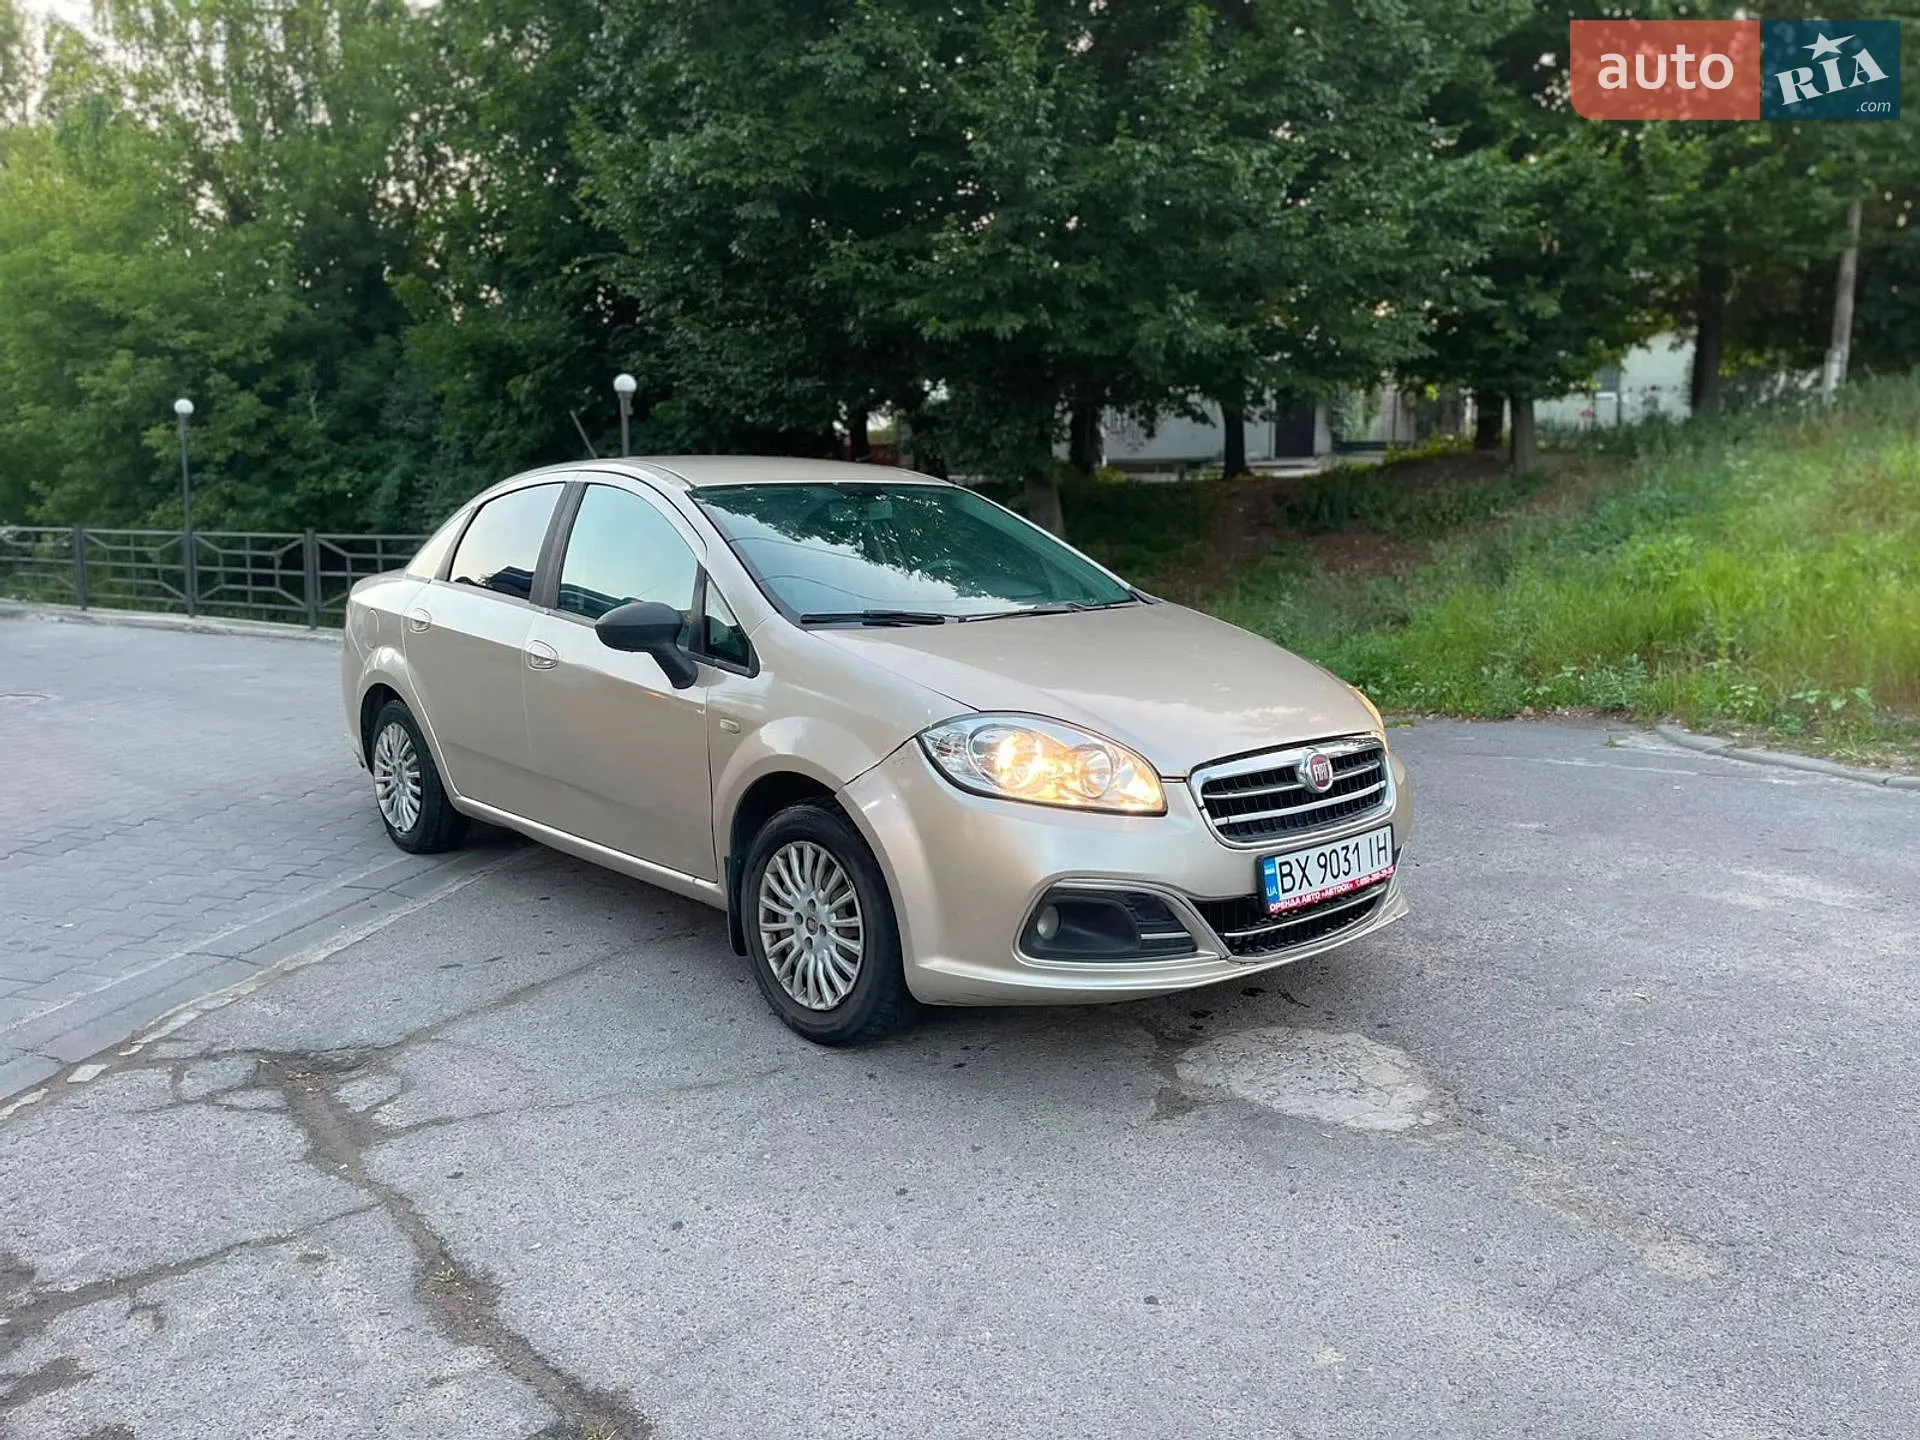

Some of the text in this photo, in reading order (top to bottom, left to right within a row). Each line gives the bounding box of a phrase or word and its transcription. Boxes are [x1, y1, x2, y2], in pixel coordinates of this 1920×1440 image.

[1278, 855, 1312, 894] BX
[1317, 842, 1361, 884] 9031
[1369, 833, 1388, 868] IH
[1266, 886, 1278, 897] UA
